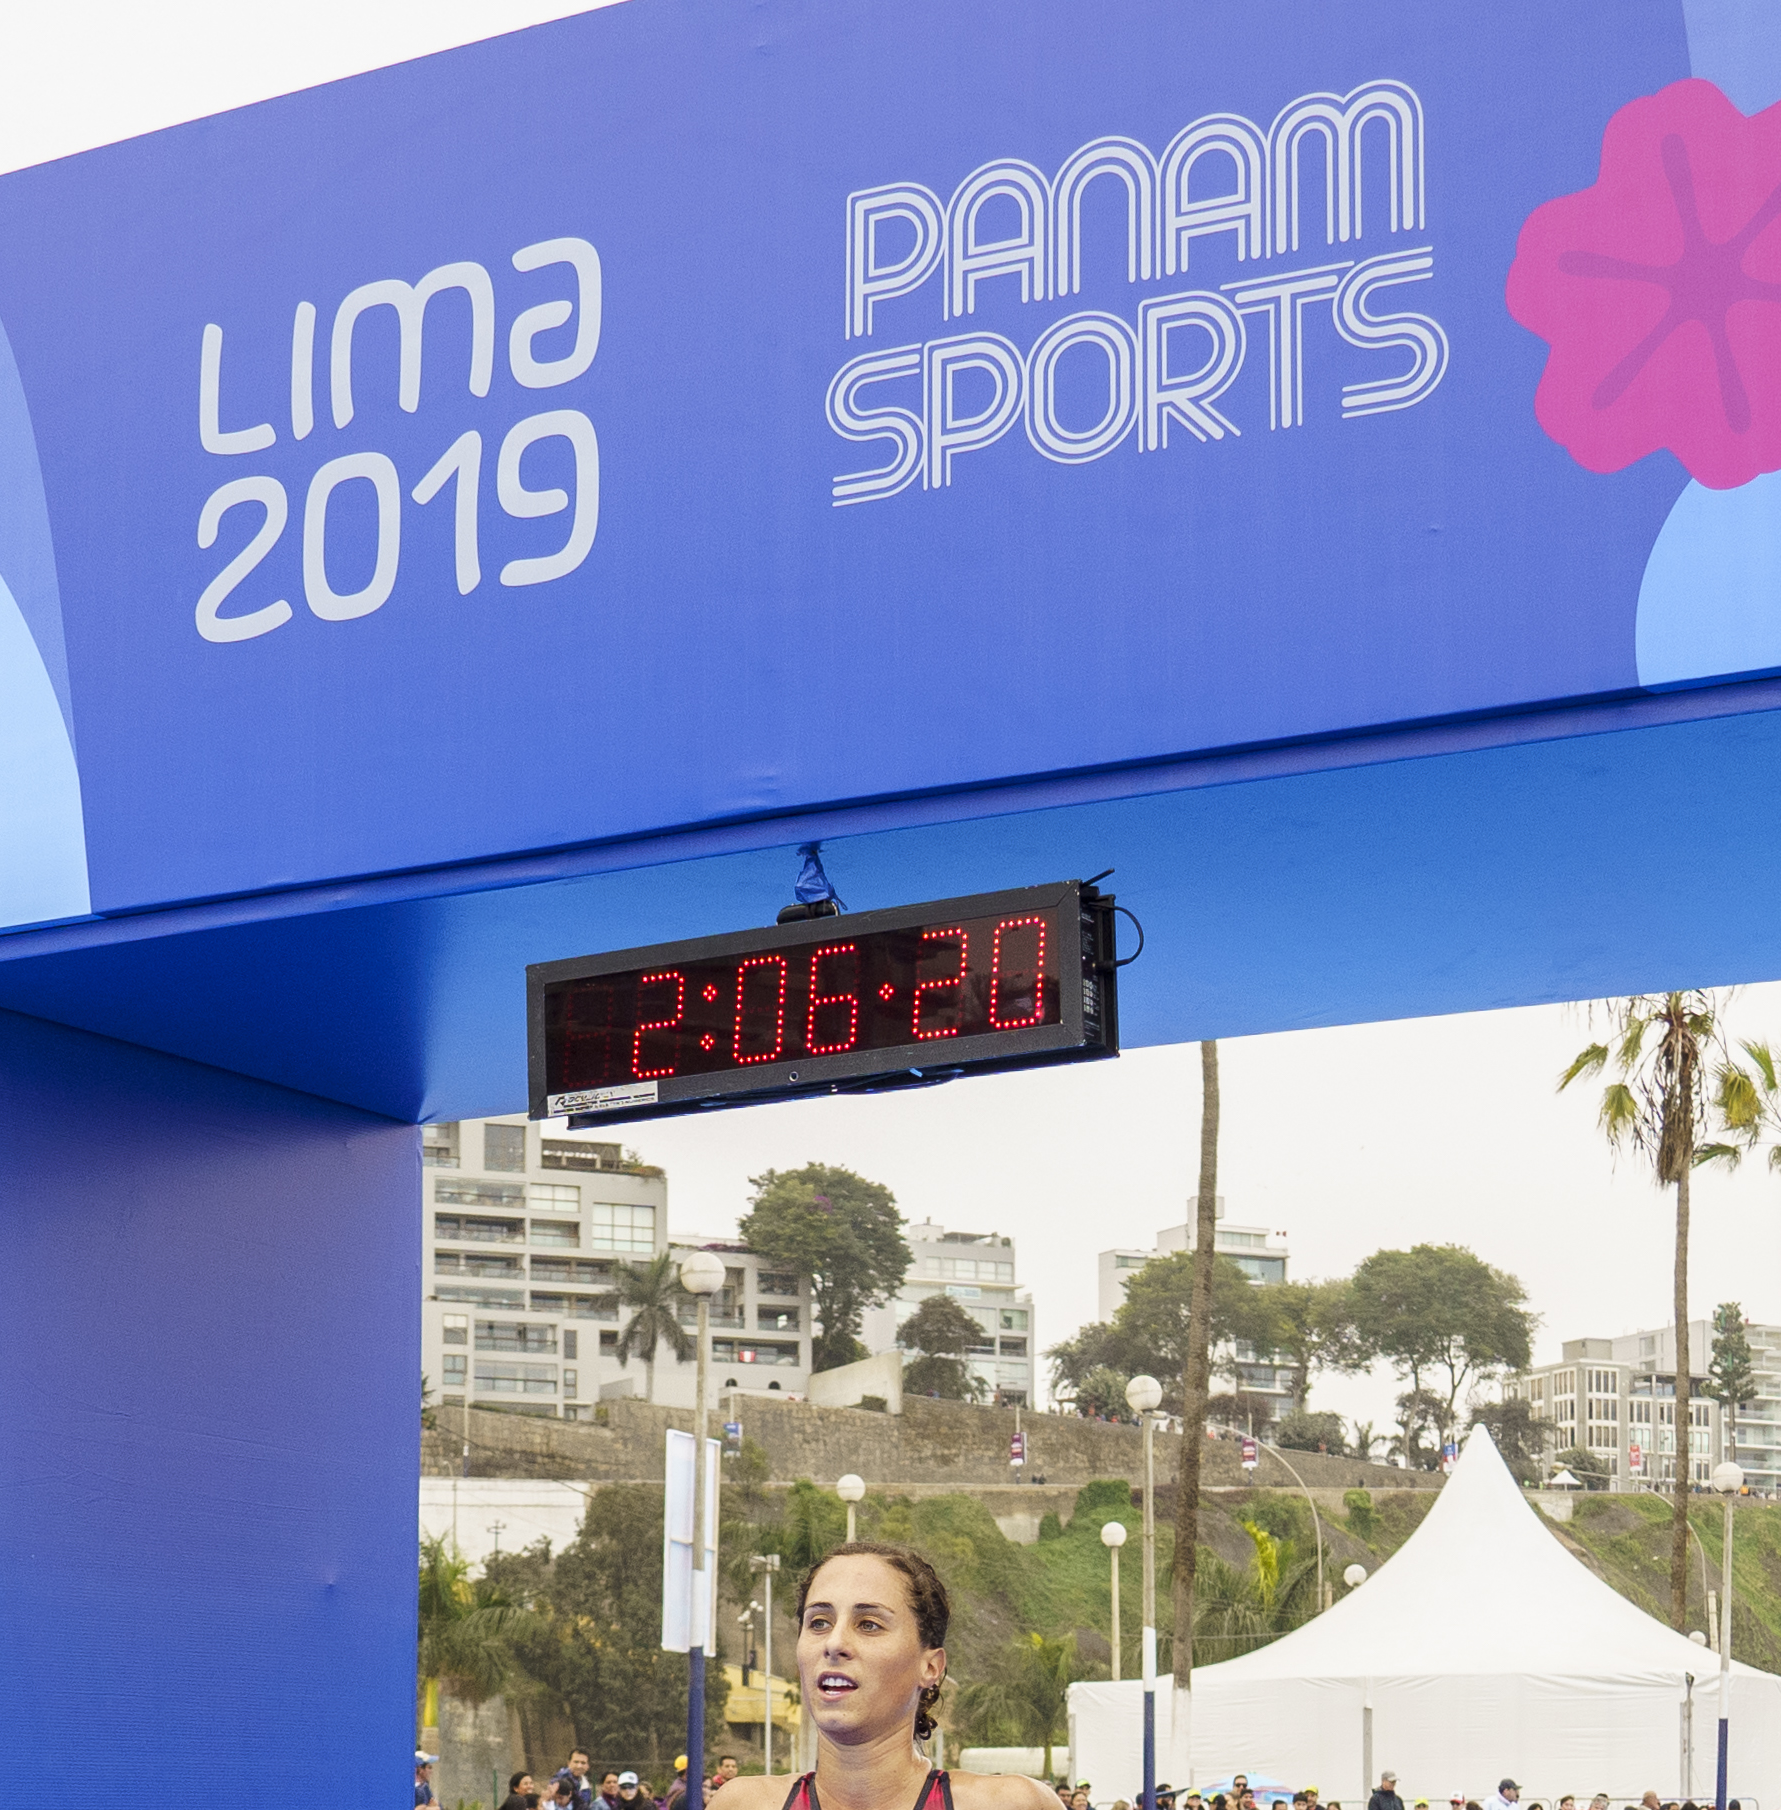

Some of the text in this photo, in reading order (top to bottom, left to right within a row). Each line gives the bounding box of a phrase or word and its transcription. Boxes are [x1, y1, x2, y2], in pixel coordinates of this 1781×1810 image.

[845, 79, 1424, 339] PANAM
[825, 246, 1449, 507] SPORTS
[195, 409, 600, 644] 2019
